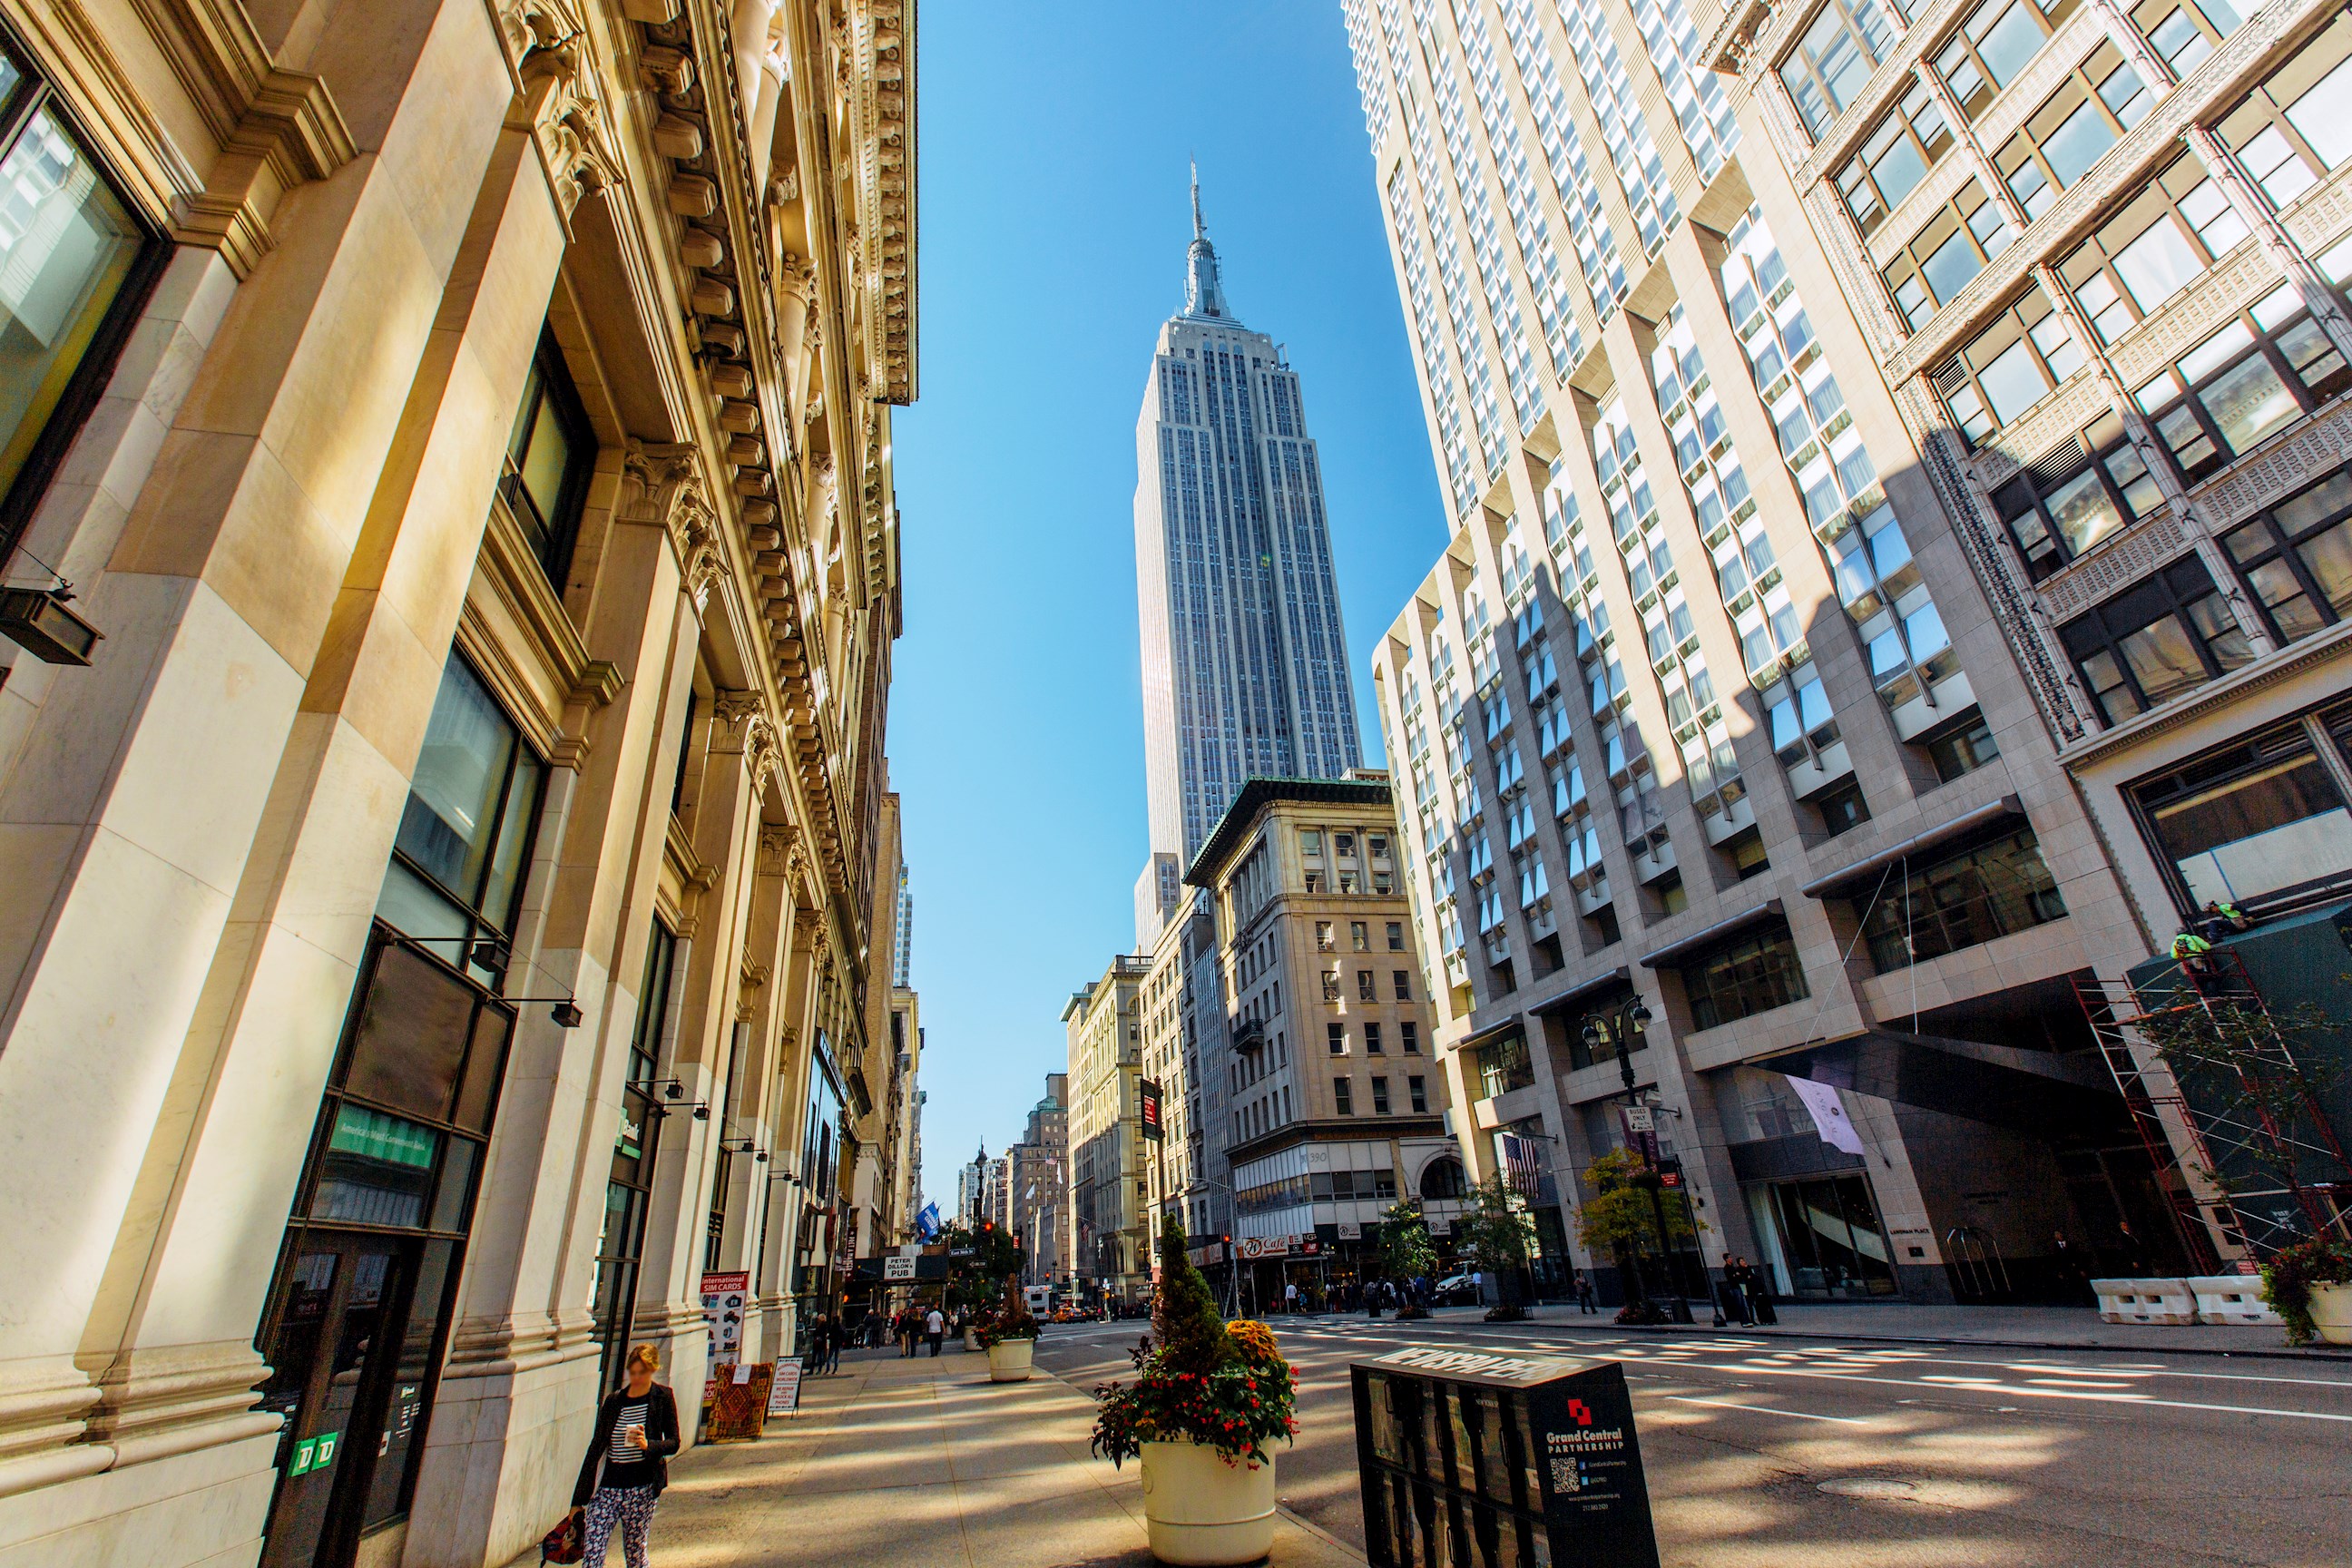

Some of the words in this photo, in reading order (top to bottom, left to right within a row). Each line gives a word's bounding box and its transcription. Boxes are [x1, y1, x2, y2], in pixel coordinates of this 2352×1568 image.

[622, 1118, 639, 1141] Bank
[1309, 1152, 1327, 1162] 390
[1263, 1238, 1285, 1249] Café
[701, 1276, 744, 1285] International
[704, 1284, 718, 1292] SIM
[718, 1282, 742, 1291] CARDS
[1371, 1348, 1583, 1381] NEWSPAPERS
[1546, 1430, 1583, 1445] Grand
[1583, 1427, 1622, 1442] Central
[318, 1441, 335, 1464] TD
[1547, 1441, 1624, 1454] PARTNERSHIP
[299, 1446, 315, 1469] TD
